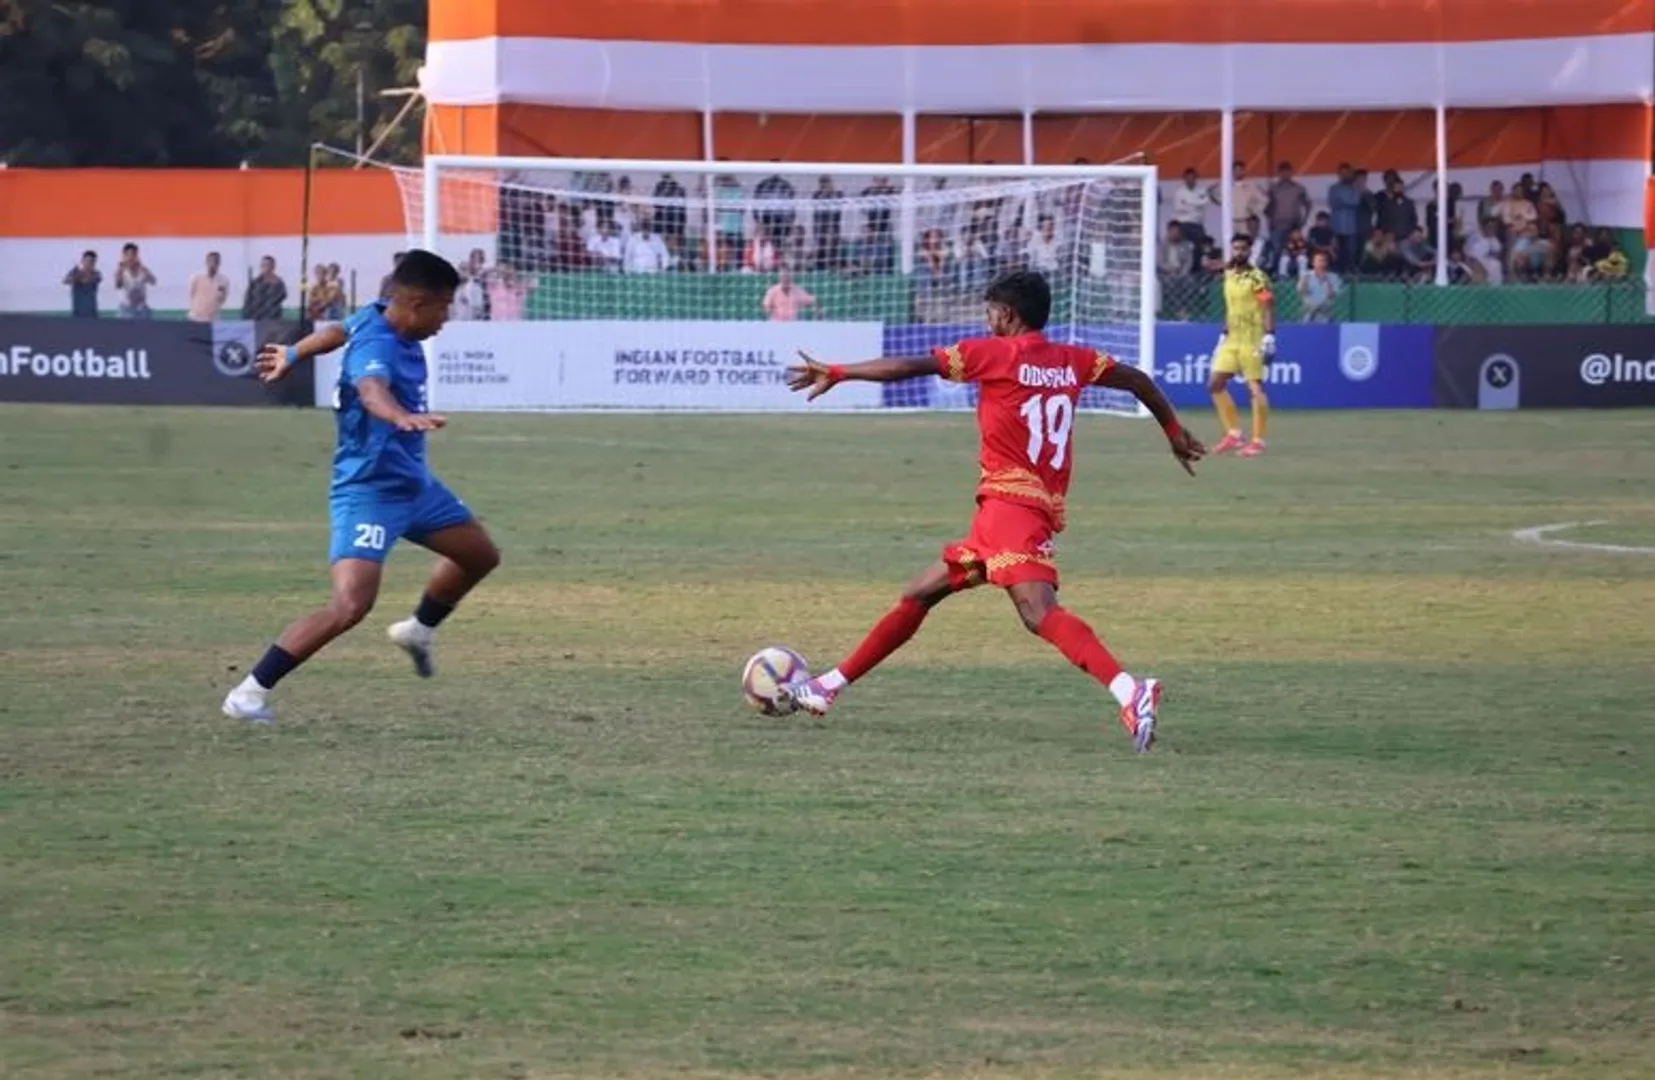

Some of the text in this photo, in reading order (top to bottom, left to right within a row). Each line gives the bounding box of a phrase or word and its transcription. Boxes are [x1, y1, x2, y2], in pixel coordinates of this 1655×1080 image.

[614, 350, 781, 366] INDIAN FOOTBALL
[614, 368, 789, 385] FORWARD TOGETH
[1019, 394, 1073, 472] 19
[353, 522, 387, 550] 20
